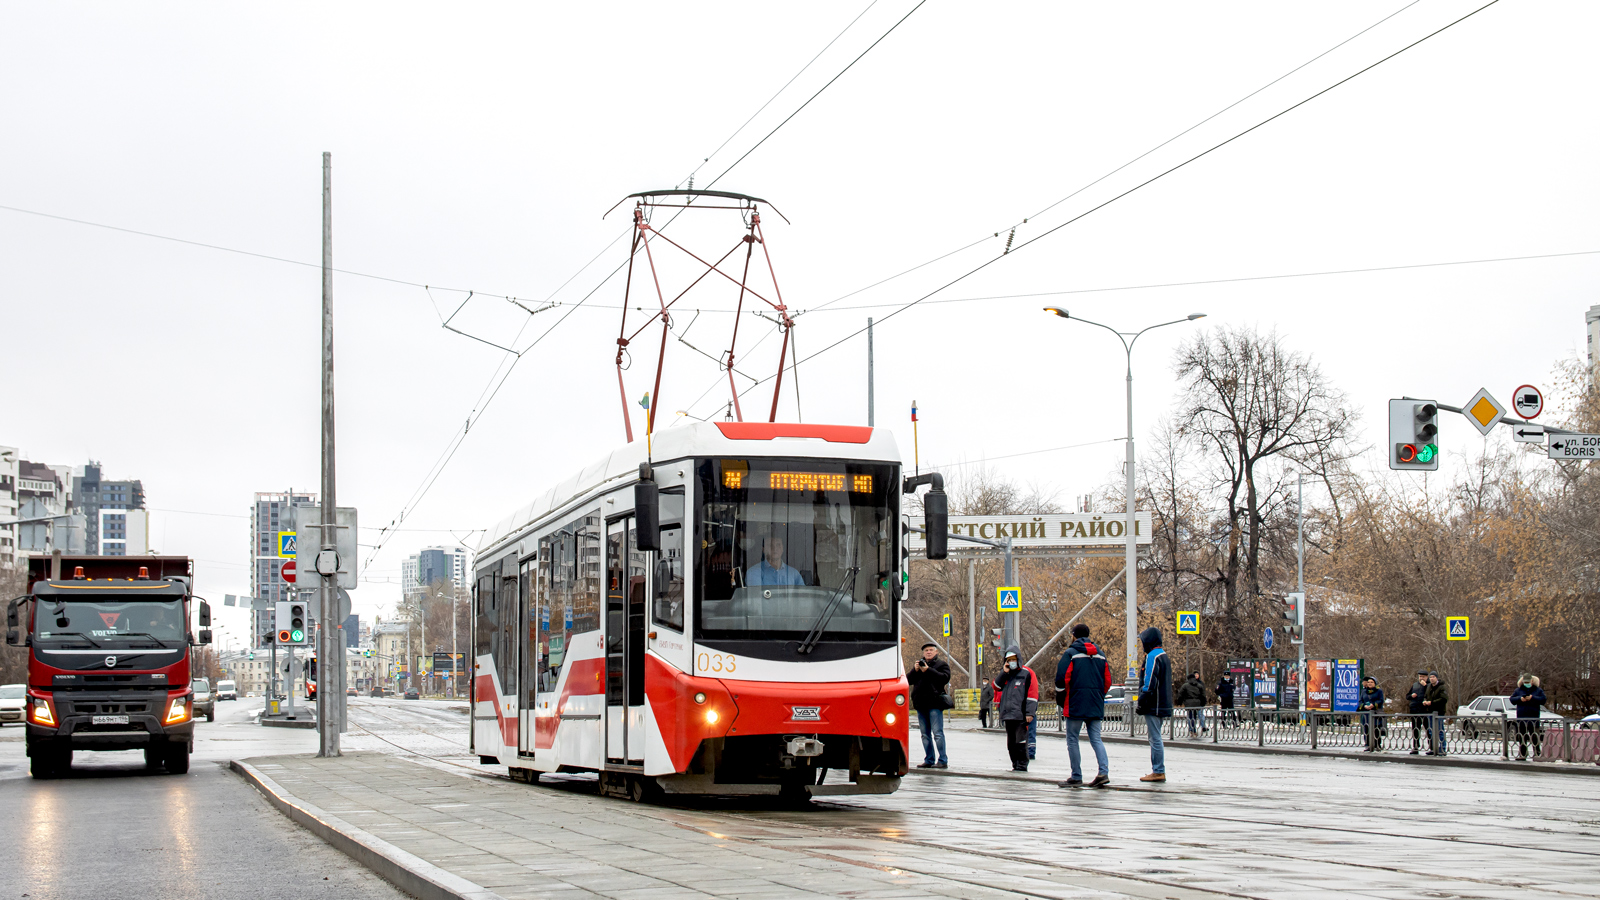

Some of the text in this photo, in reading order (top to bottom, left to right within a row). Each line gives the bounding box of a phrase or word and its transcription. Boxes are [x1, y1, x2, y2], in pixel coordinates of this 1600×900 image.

[1564, 439, 1580, 447] ул.
[1564, 447, 1595, 456] BORIS
[697, 653, 736, 673] 033
[1336, 669, 1358, 687] ХОР
